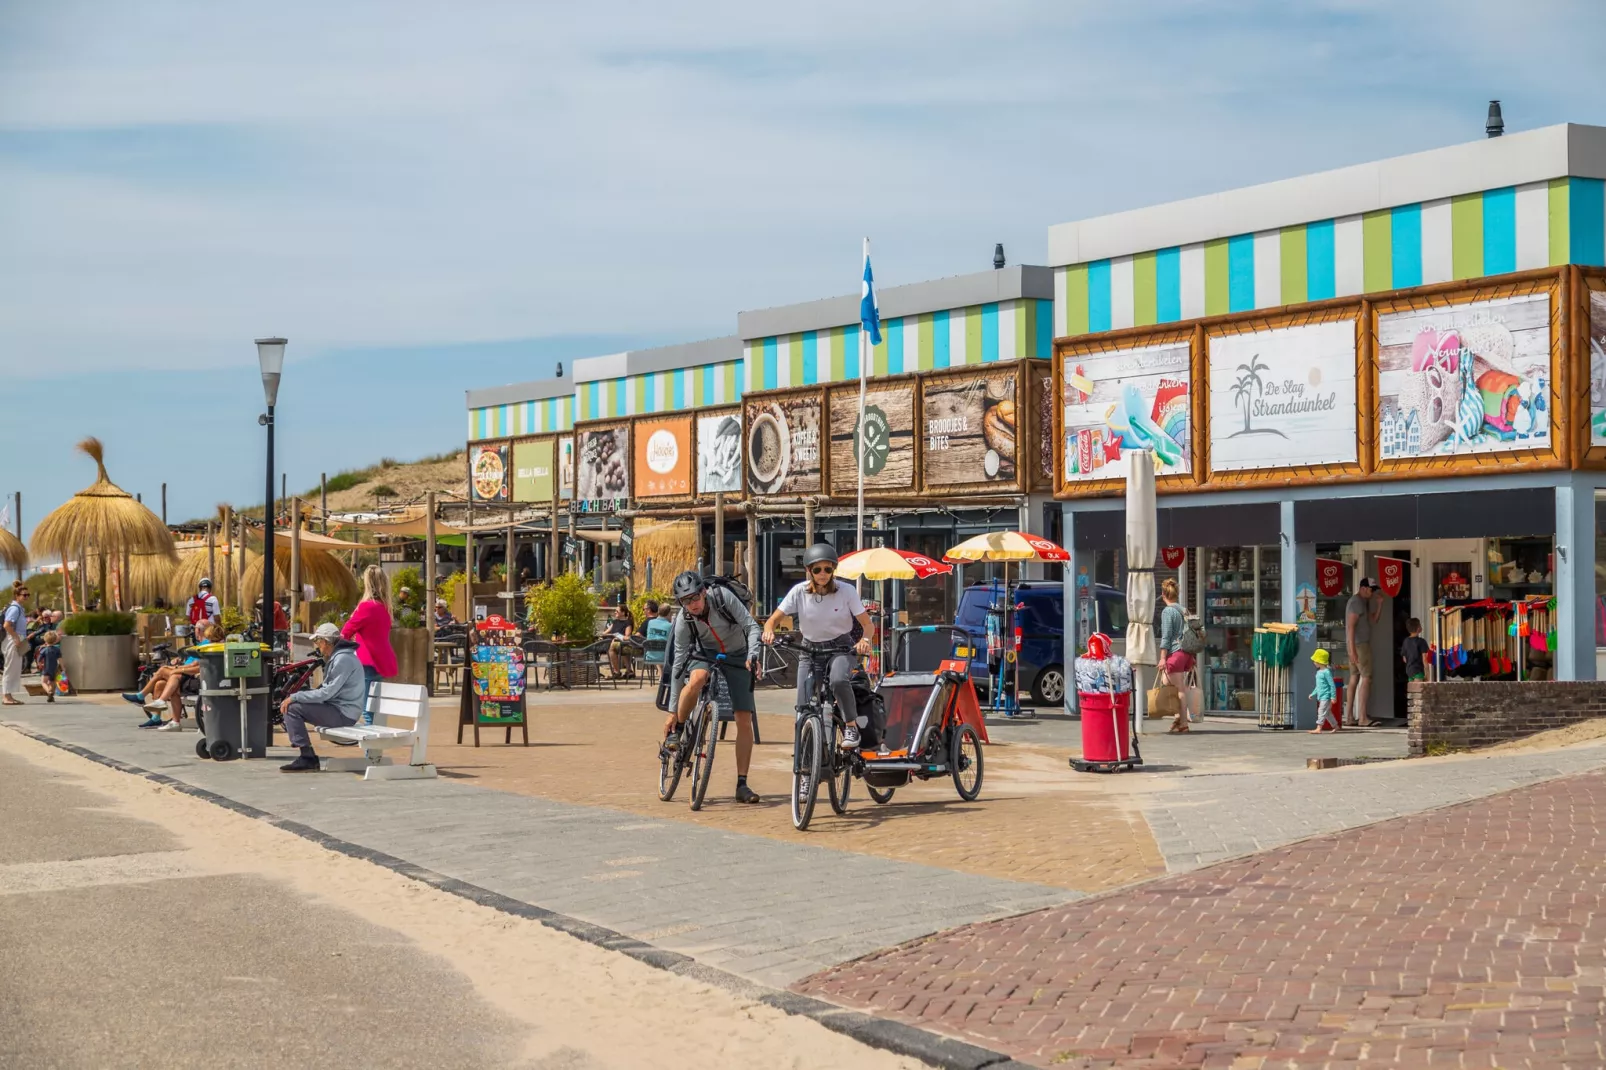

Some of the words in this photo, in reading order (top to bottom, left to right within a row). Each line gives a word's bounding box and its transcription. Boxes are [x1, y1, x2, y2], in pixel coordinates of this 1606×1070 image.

[1265, 381, 1280, 396] De
[1282, 380, 1305, 398] Slag
[1252, 392, 1336, 417] Strandwinkel
[930, 435, 949, 451] BITES
[794, 447, 817, 461] SWEETS
[571, 499, 600, 513] BEACH
[602, 498, 620, 512] BAR
